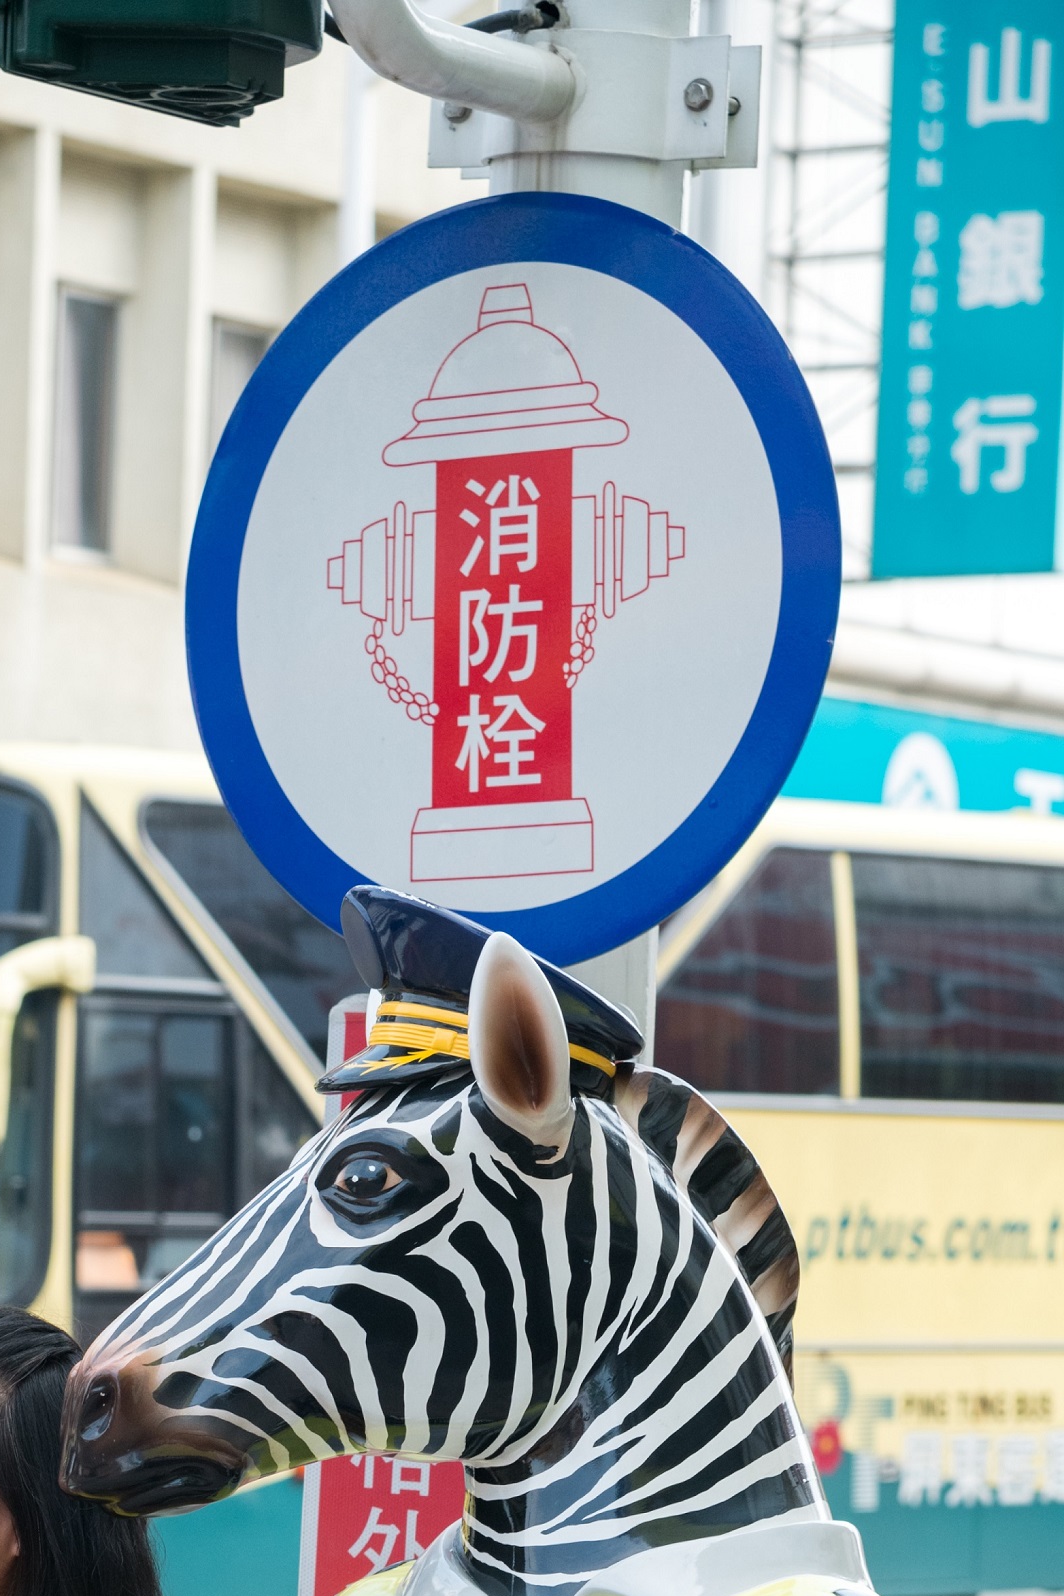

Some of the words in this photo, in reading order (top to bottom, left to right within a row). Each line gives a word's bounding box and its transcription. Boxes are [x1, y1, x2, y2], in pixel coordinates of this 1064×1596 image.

[950, 26, 1053, 494] 山銀行
[455, 474, 547, 793] 消防栓
